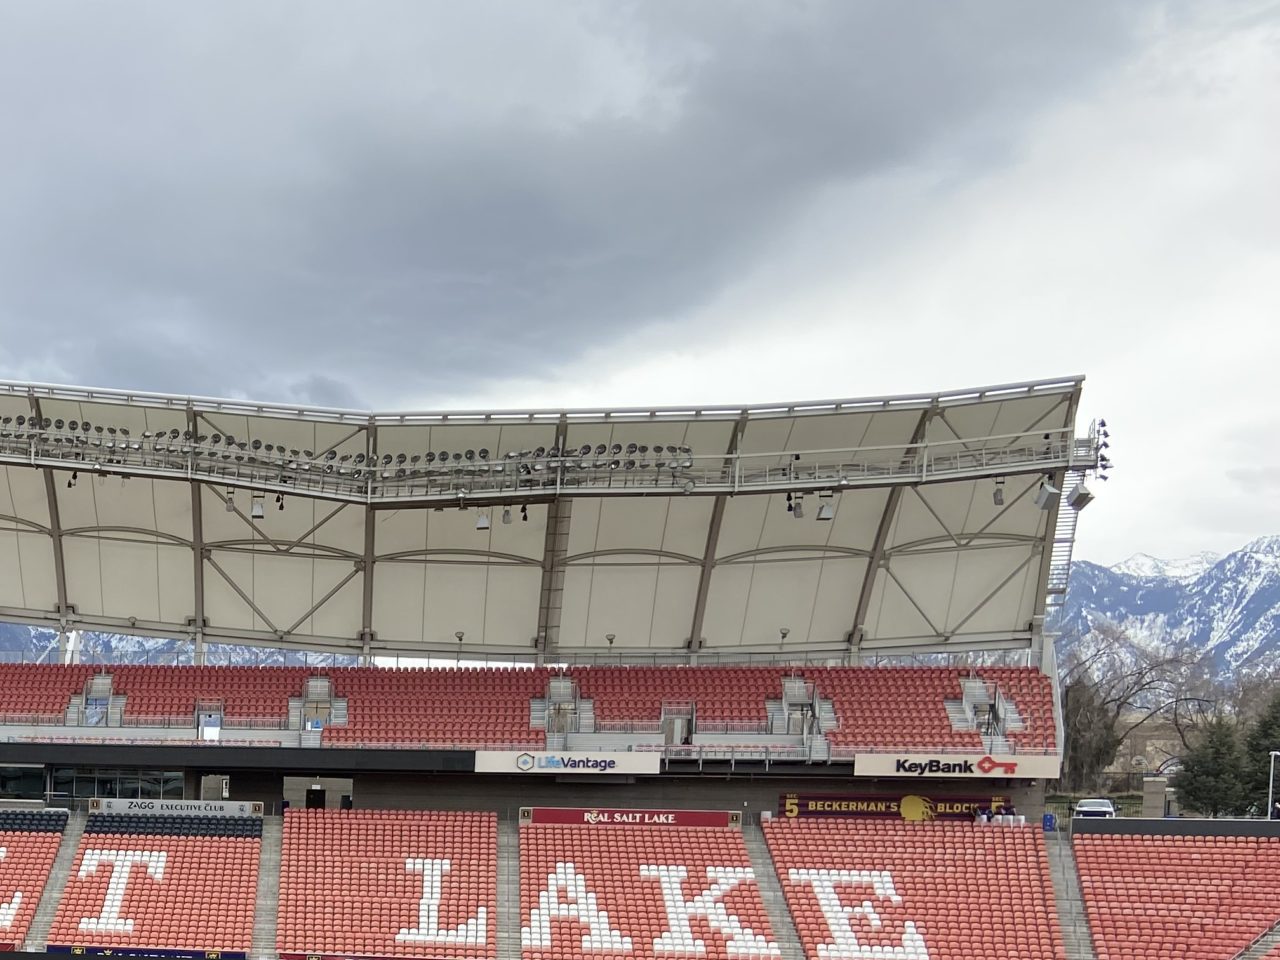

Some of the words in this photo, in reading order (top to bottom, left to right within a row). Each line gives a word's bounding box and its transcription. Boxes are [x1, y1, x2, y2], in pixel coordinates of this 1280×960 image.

[538, 755, 616, 771] LifeVantage
[896, 759, 974, 775] KeyBank
[128, 801, 155, 810] ZAGG
[785, 799, 799, 817] 5
[808, 801, 898, 812] BECKERMAN'S
[613, 813, 642, 823] SALT
[644, 814, 677, 823] LAKE
